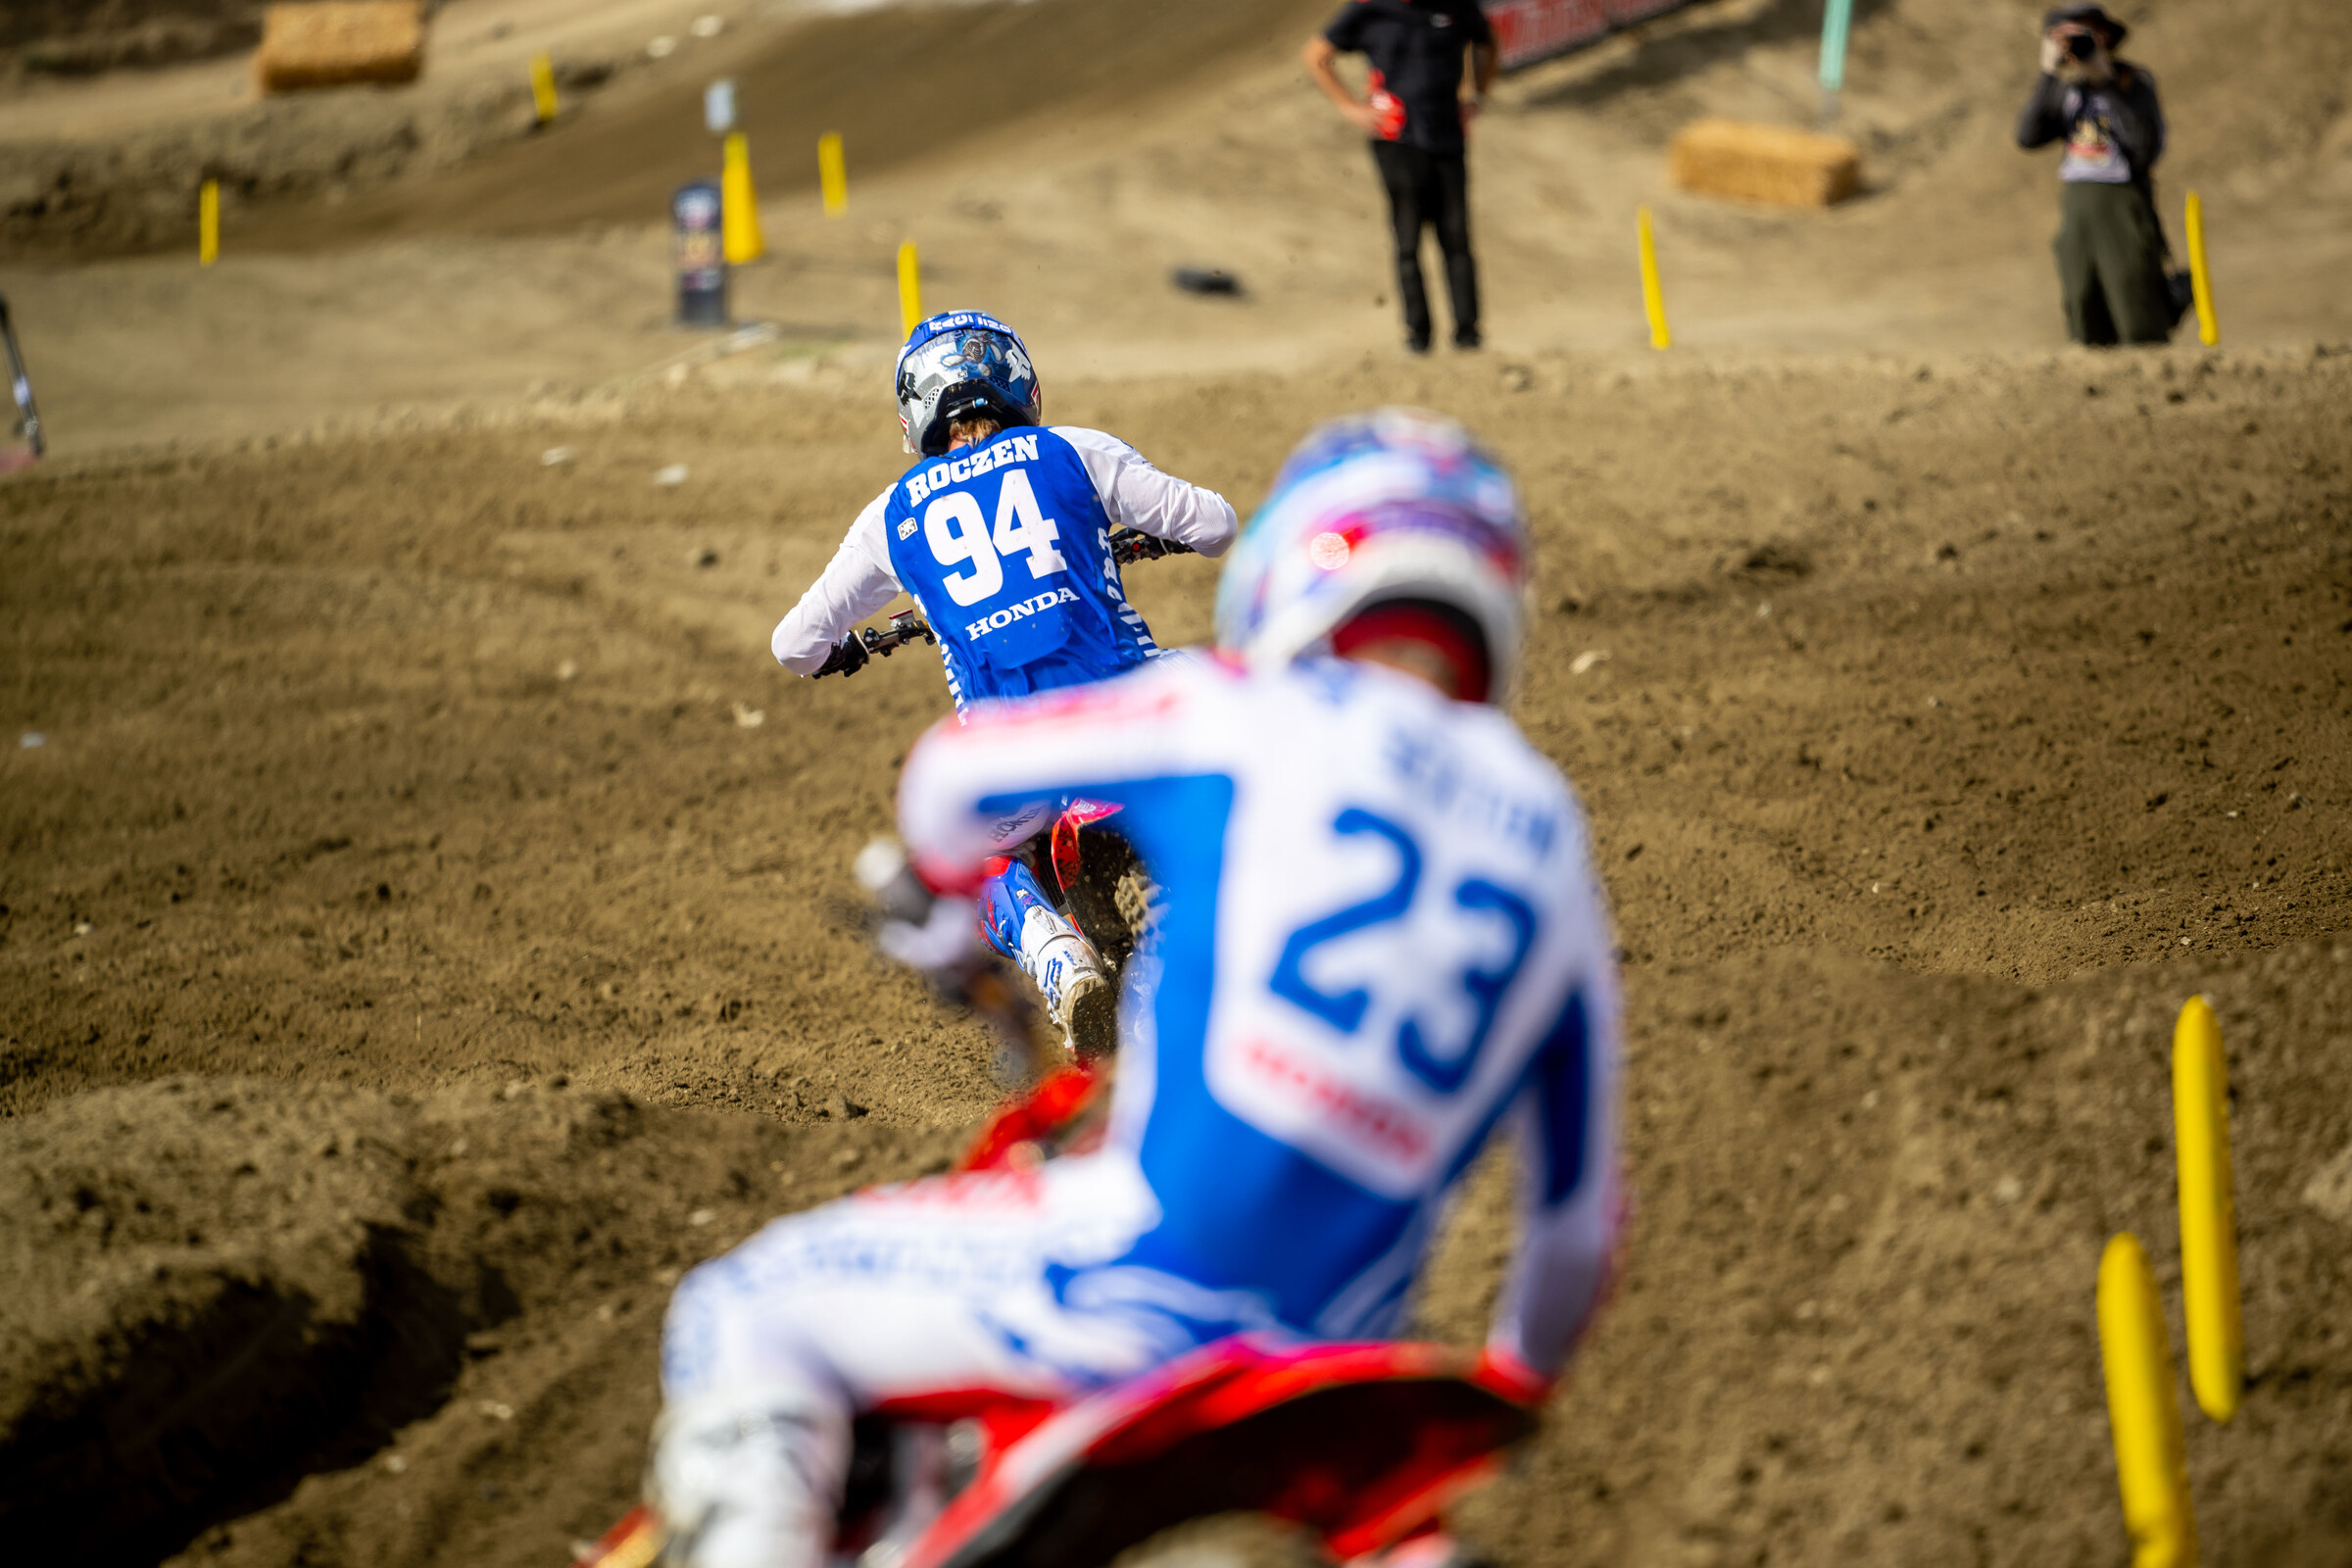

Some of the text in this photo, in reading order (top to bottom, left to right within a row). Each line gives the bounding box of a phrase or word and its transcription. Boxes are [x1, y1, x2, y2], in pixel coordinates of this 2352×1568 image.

[906, 434, 1039, 508] ROCZEN
[924, 468, 1067, 607] 94
[965, 587, 1080, 641] HONDA
[991, 806, 1043, 843] HOND
[1271, 808, 1536, 1093] 23
